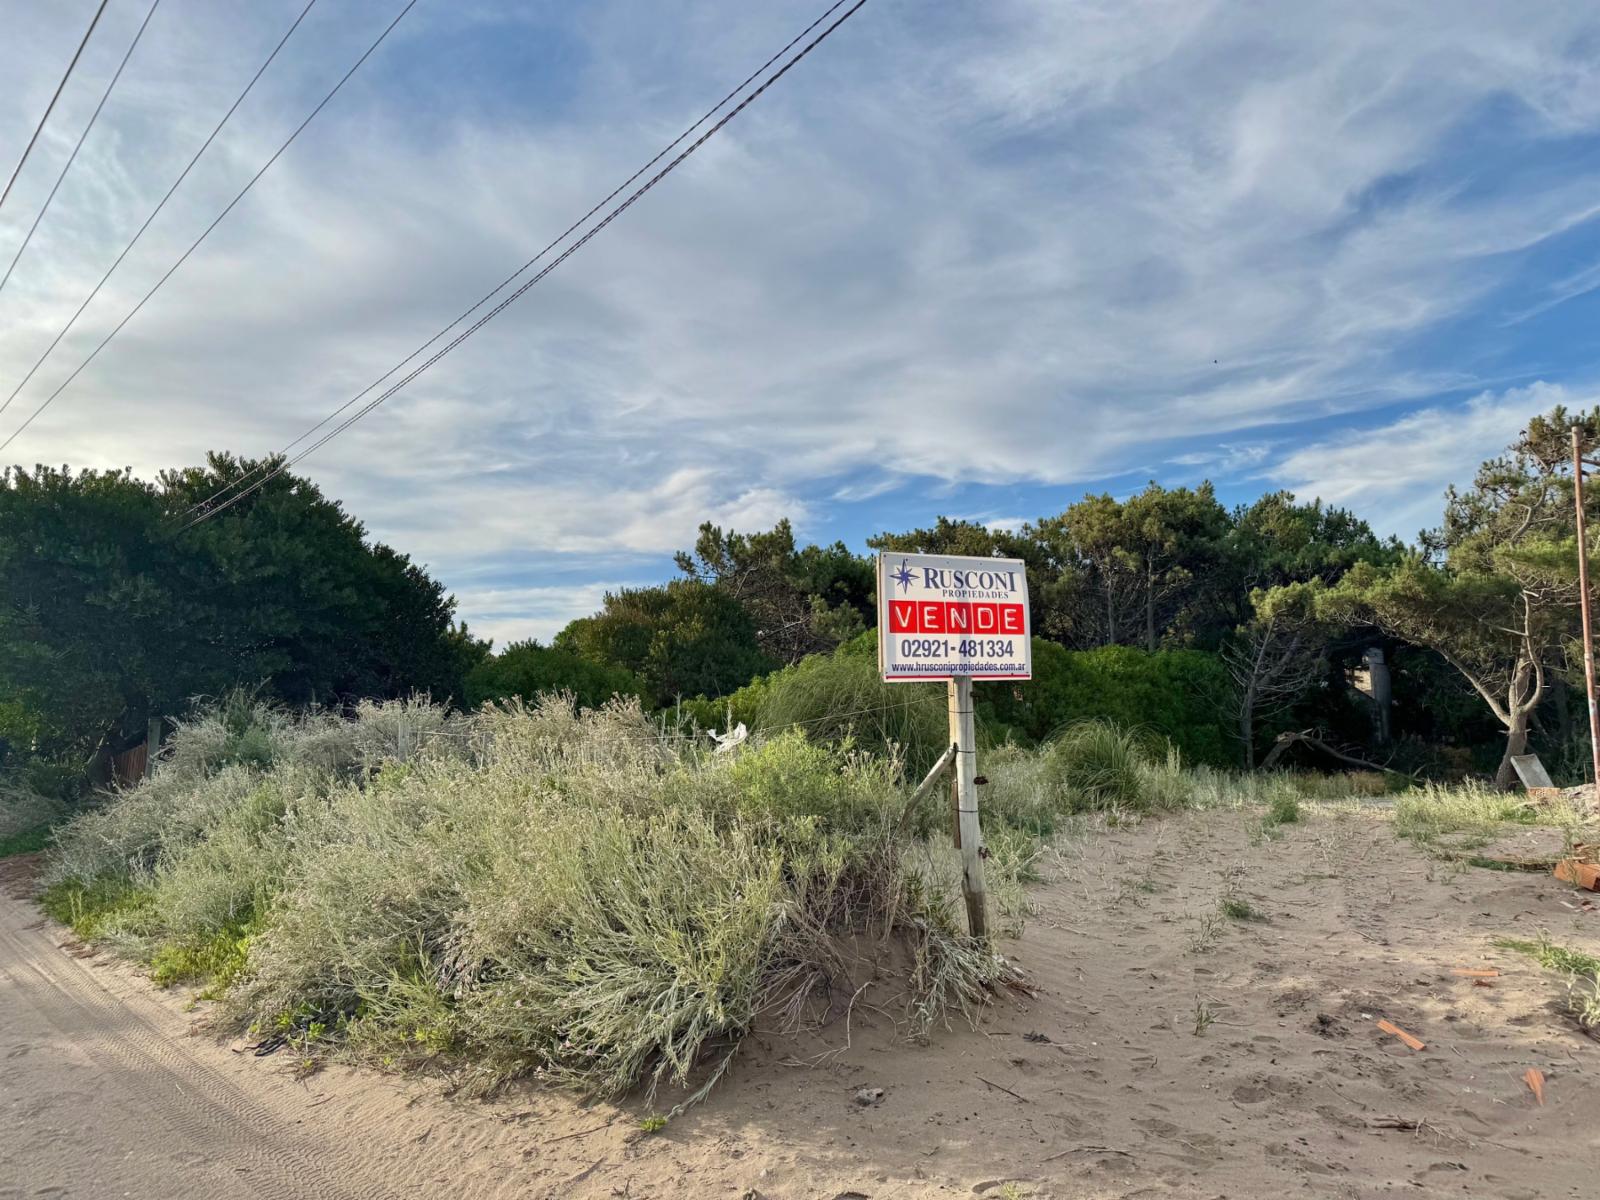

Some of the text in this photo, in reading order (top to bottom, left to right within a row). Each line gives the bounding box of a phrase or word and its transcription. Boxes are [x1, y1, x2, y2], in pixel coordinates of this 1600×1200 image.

[942, 589, 1009, 599] PROPIEDADES
[895, 605, 1018, 630] VENDE
[901, 639, 1014, 658] 02921-481334
[891, 661, 1026, 673] www.hrusconipropiedades.com.ar
